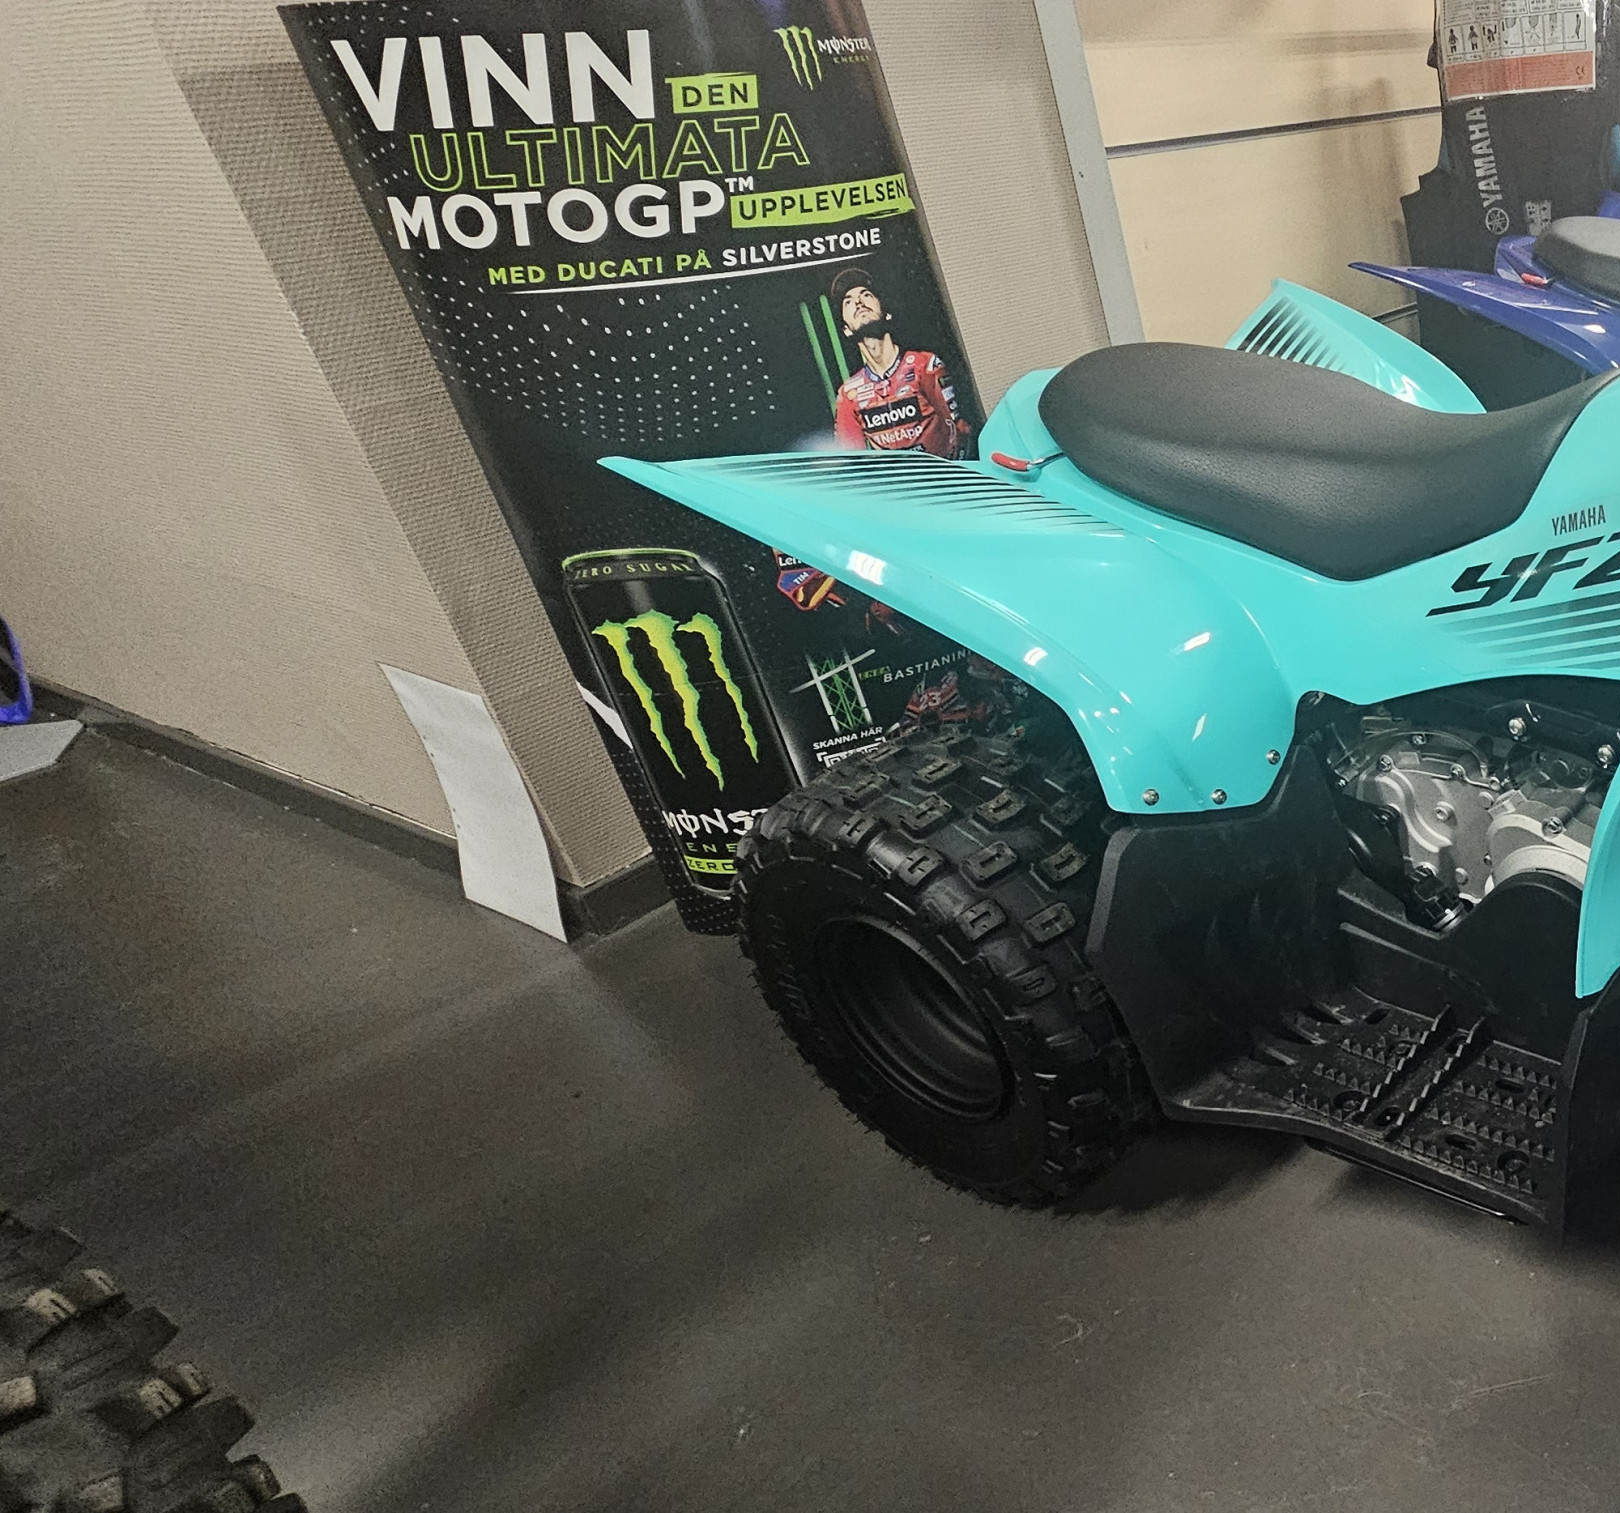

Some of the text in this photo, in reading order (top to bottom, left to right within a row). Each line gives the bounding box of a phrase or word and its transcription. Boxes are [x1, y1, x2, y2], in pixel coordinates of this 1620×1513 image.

[330, 29, 656, 132] VINN
[681, 82, 750, 108] DEN
[410, 113, 810, 192] ULTIMATA
[1466, 106, 1502, 208] YAMAHA
[738, 176, 906, 221] UPPLEVELSEN
[489, 228, 882, 286] MED DUCATI PÅ SILVERSTONE
[864, 404, 917, 428] Lenovo
[880, 425, 924, 446] NetApp
[1552, 504, 1607, 536] YAMAHA
[792, 571, 809, 585] TIM
[919, 691, 941, 711] 23
[813, 733, 858, 750] SKANNA
[686, 842, 738, 853] ENE
[687, 858, 737, 871] ZERO
